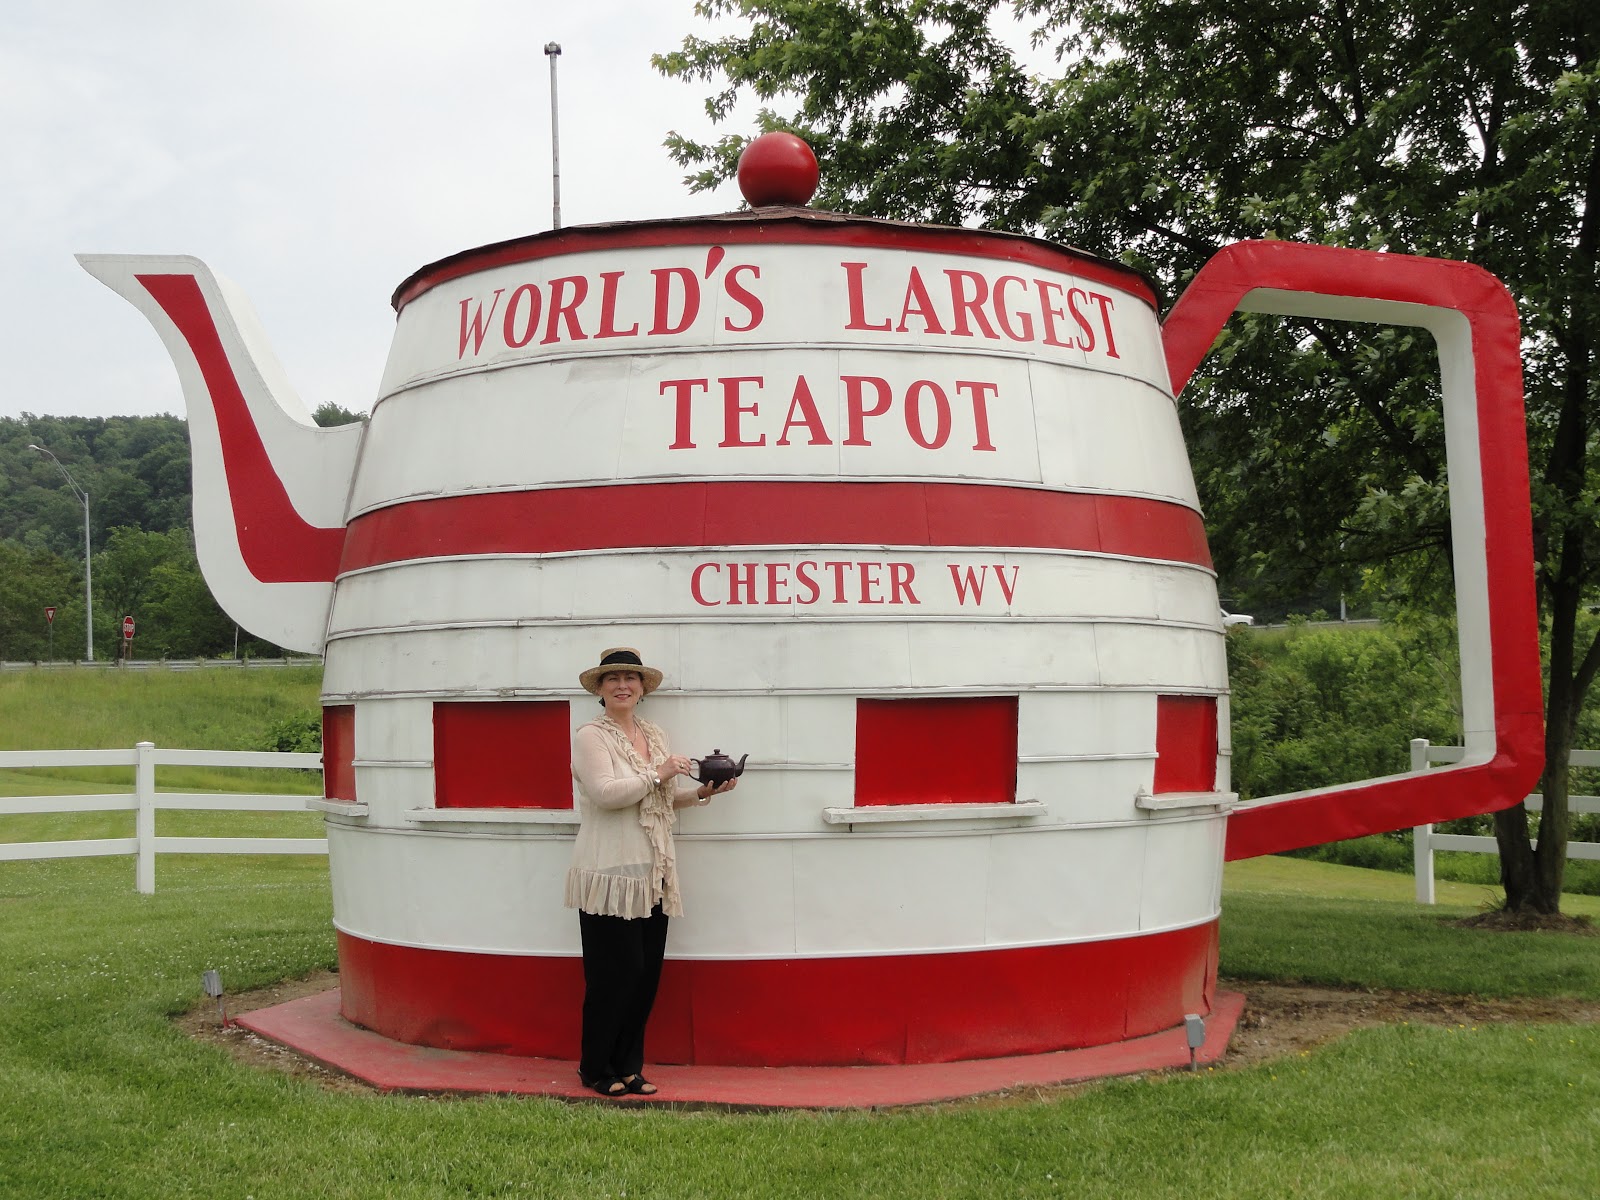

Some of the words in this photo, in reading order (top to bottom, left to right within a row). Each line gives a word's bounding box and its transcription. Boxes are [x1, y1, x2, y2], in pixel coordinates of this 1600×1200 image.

[458, 246, 765, 357] WORLD'S
[841, 261, 1121, 359] LARGEST
[659, 375, 999, 452] TEAPOT
[690, 560, 921, 607] CHESTER
[947, 564, 1020, 606] WV
[124, 623, 135, 632] STOP
